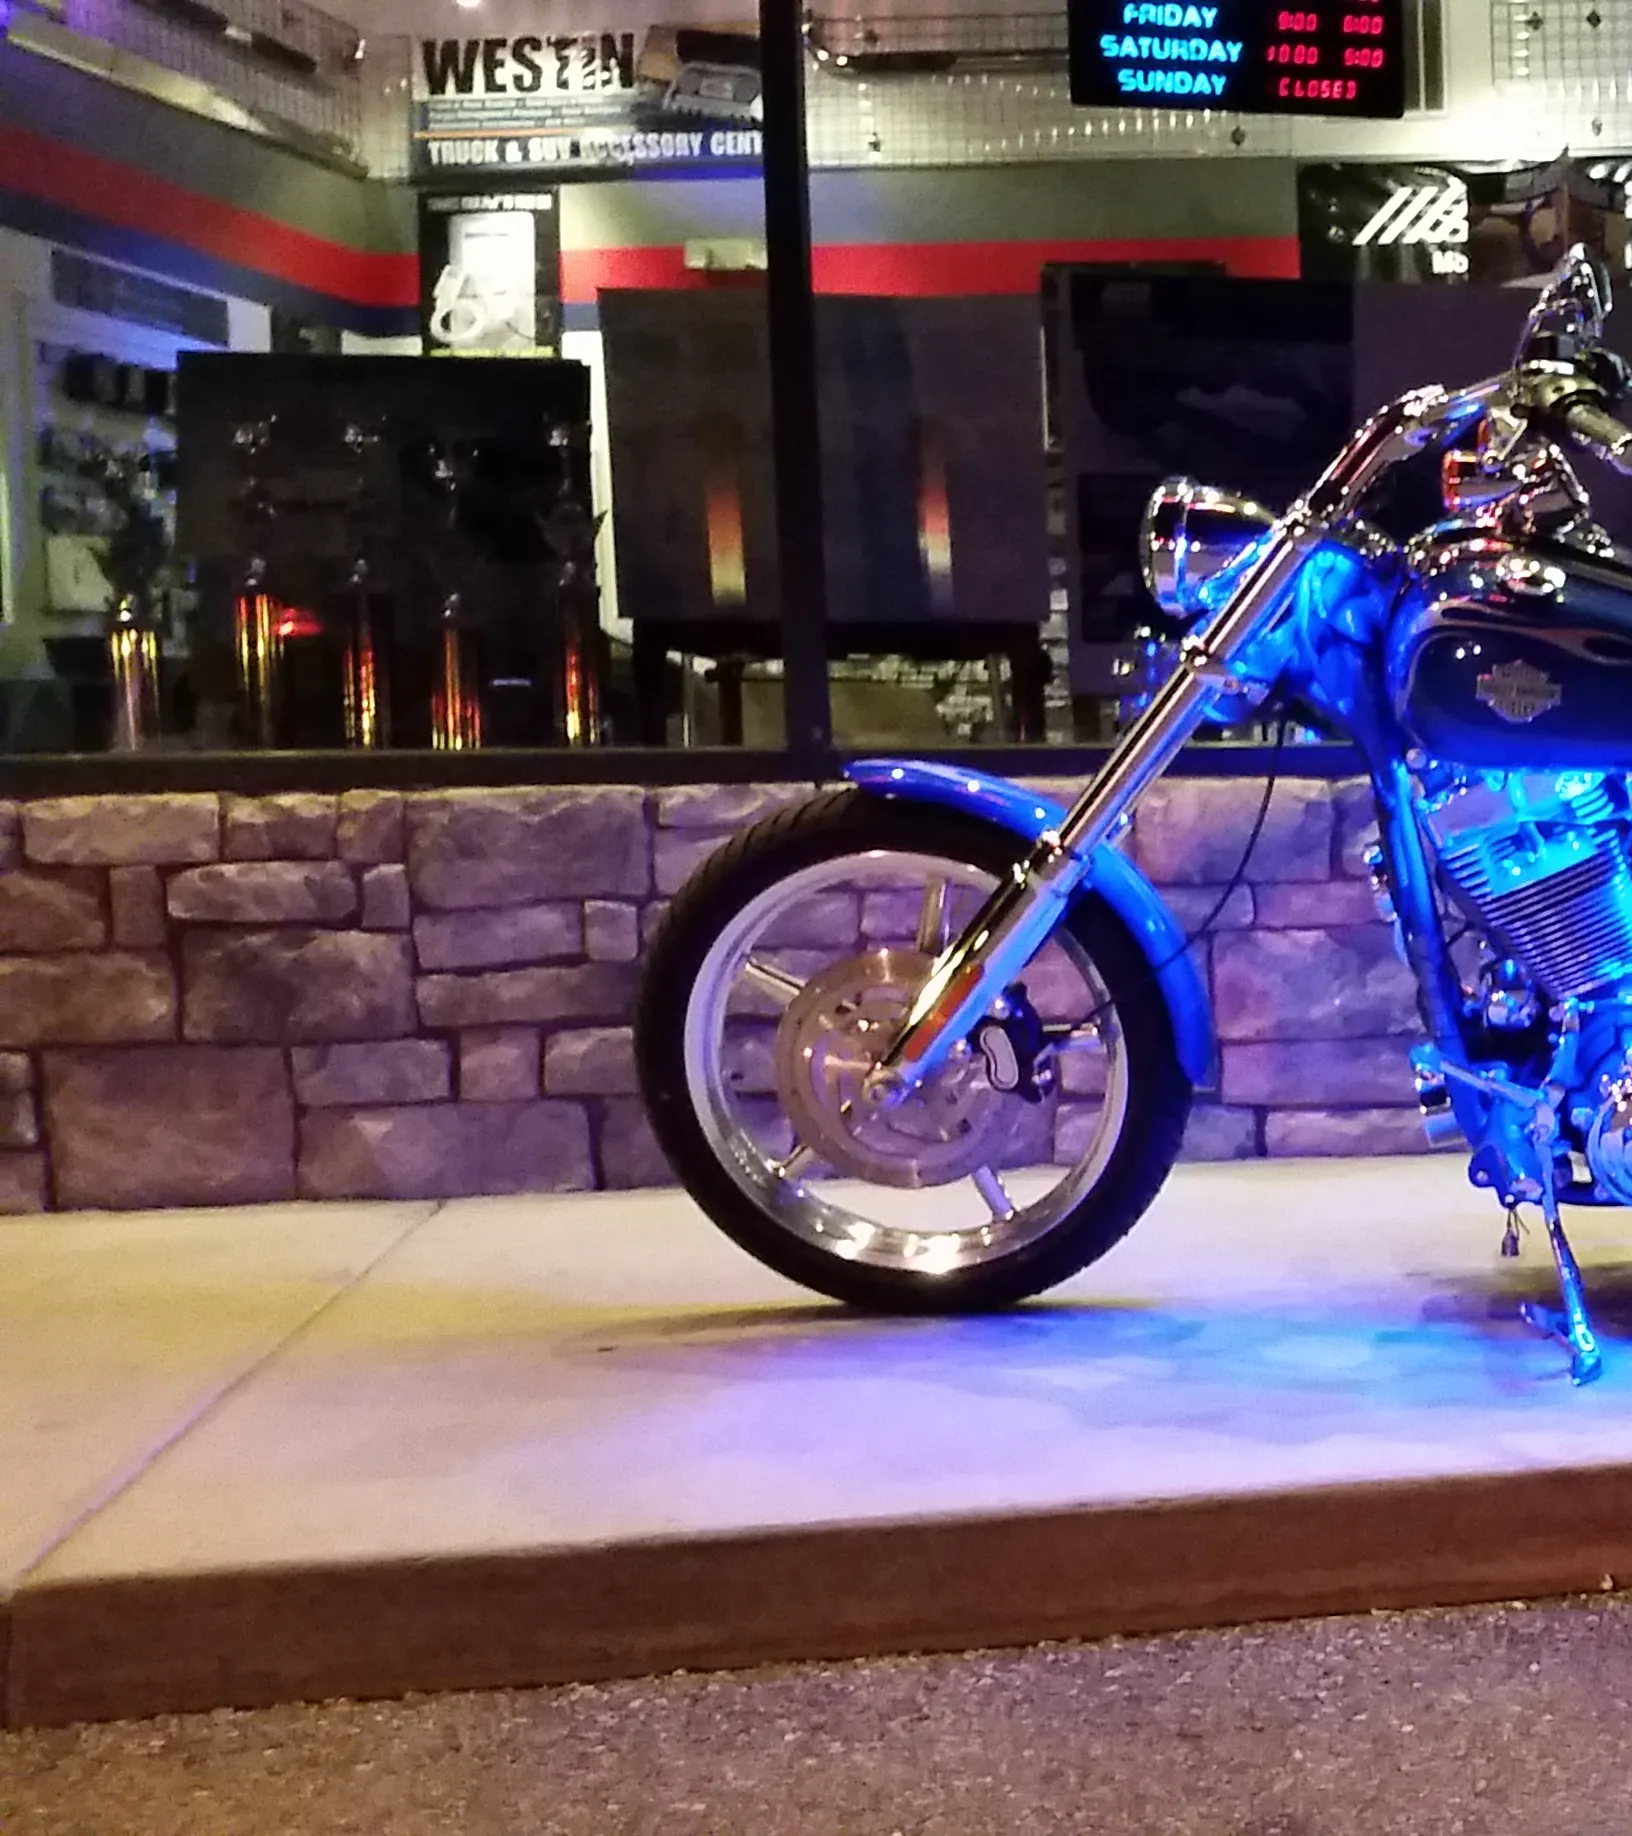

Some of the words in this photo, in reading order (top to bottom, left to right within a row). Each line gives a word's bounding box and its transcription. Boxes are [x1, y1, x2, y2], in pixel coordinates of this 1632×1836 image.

[1123, 2, 1218, 29] FRIDAY
[1099, 34, 1244, 63] SATURDAY
[422, 32, 635, 96] WESTIN
[1117, 68, 1227, 96] SUNDAY
[1278, 77, 1357, 99] CLOSED
[427, 139, 499, 166] TRUCK
